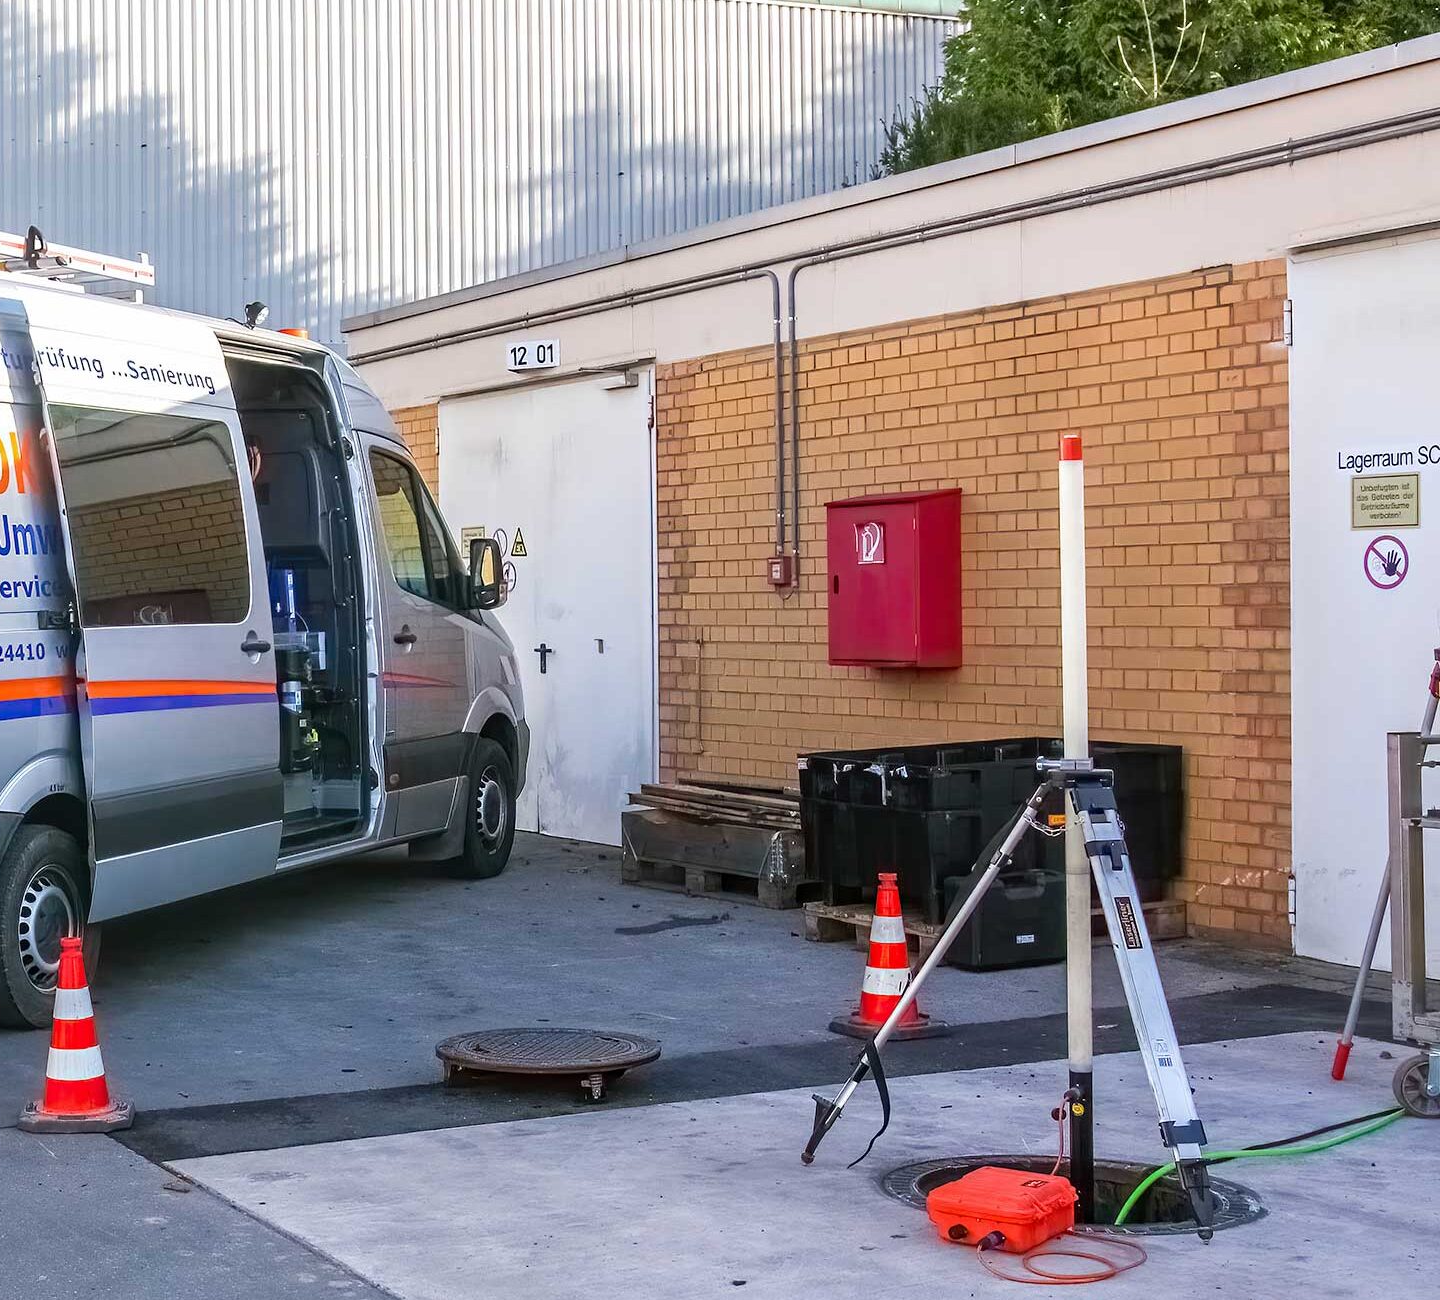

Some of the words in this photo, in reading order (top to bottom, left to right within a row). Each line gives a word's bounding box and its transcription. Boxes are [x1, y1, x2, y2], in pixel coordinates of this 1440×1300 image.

[510, 346, 528, 367] 12
[536, 343, 554, 364] 01
[1338, 451, 1413, 473] Lagerraum
